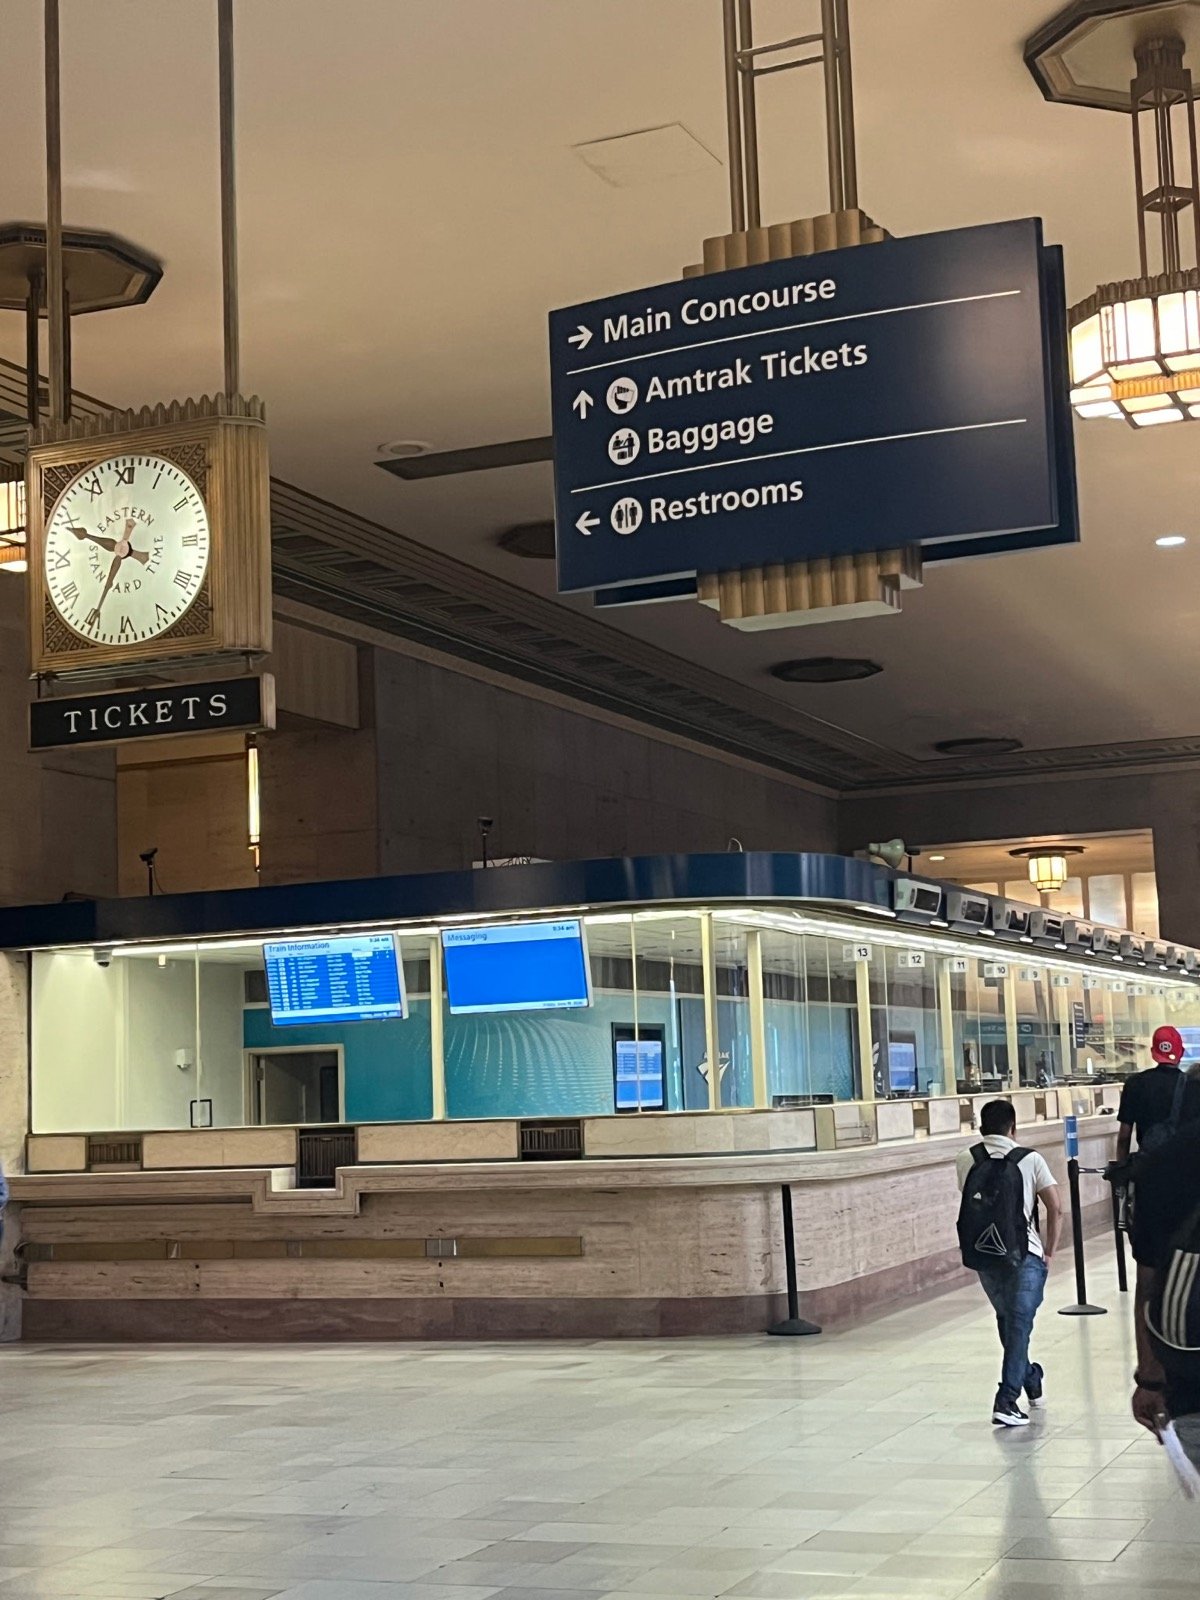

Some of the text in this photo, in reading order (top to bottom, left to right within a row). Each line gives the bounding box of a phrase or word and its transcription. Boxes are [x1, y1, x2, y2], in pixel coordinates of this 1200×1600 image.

[603, 279, 837, 344] Main Concourse
[645, 342, 868, 403] Amtrak Tickets
[648, 413, 774, 454] Baggage
[115, 466, 135, 487] XII
[84, 478, 104, 502] XI
[173, 496, 189, 512] II
[650, 480, 804, 524] Restrooms
[61, 510, 80, 529] X
[96, 507, 155, 533] EASTERN
[182, 534, 198, 547] III
[55, 549, 71, 569] IX
[145, 535, 164, 574] TIME
[88, 545, 142, 594] STANARD
[173, 570, 192, 589] IIII
[60, 581, 80, 609] VIII
[154, 603, 169, 621] V
[120, 615, 135, 634] VI
[63, 693, 228, 733] TICKETS
[447, 932, 487, 942] Messaging
[268, 942, 330, 953] Train Information
[858, 948, 868, 957] 13
[912, 955, 922, 964] 12
[997, 966, 1006, 974] 10
[1033, 970, 1038, 978] 9
